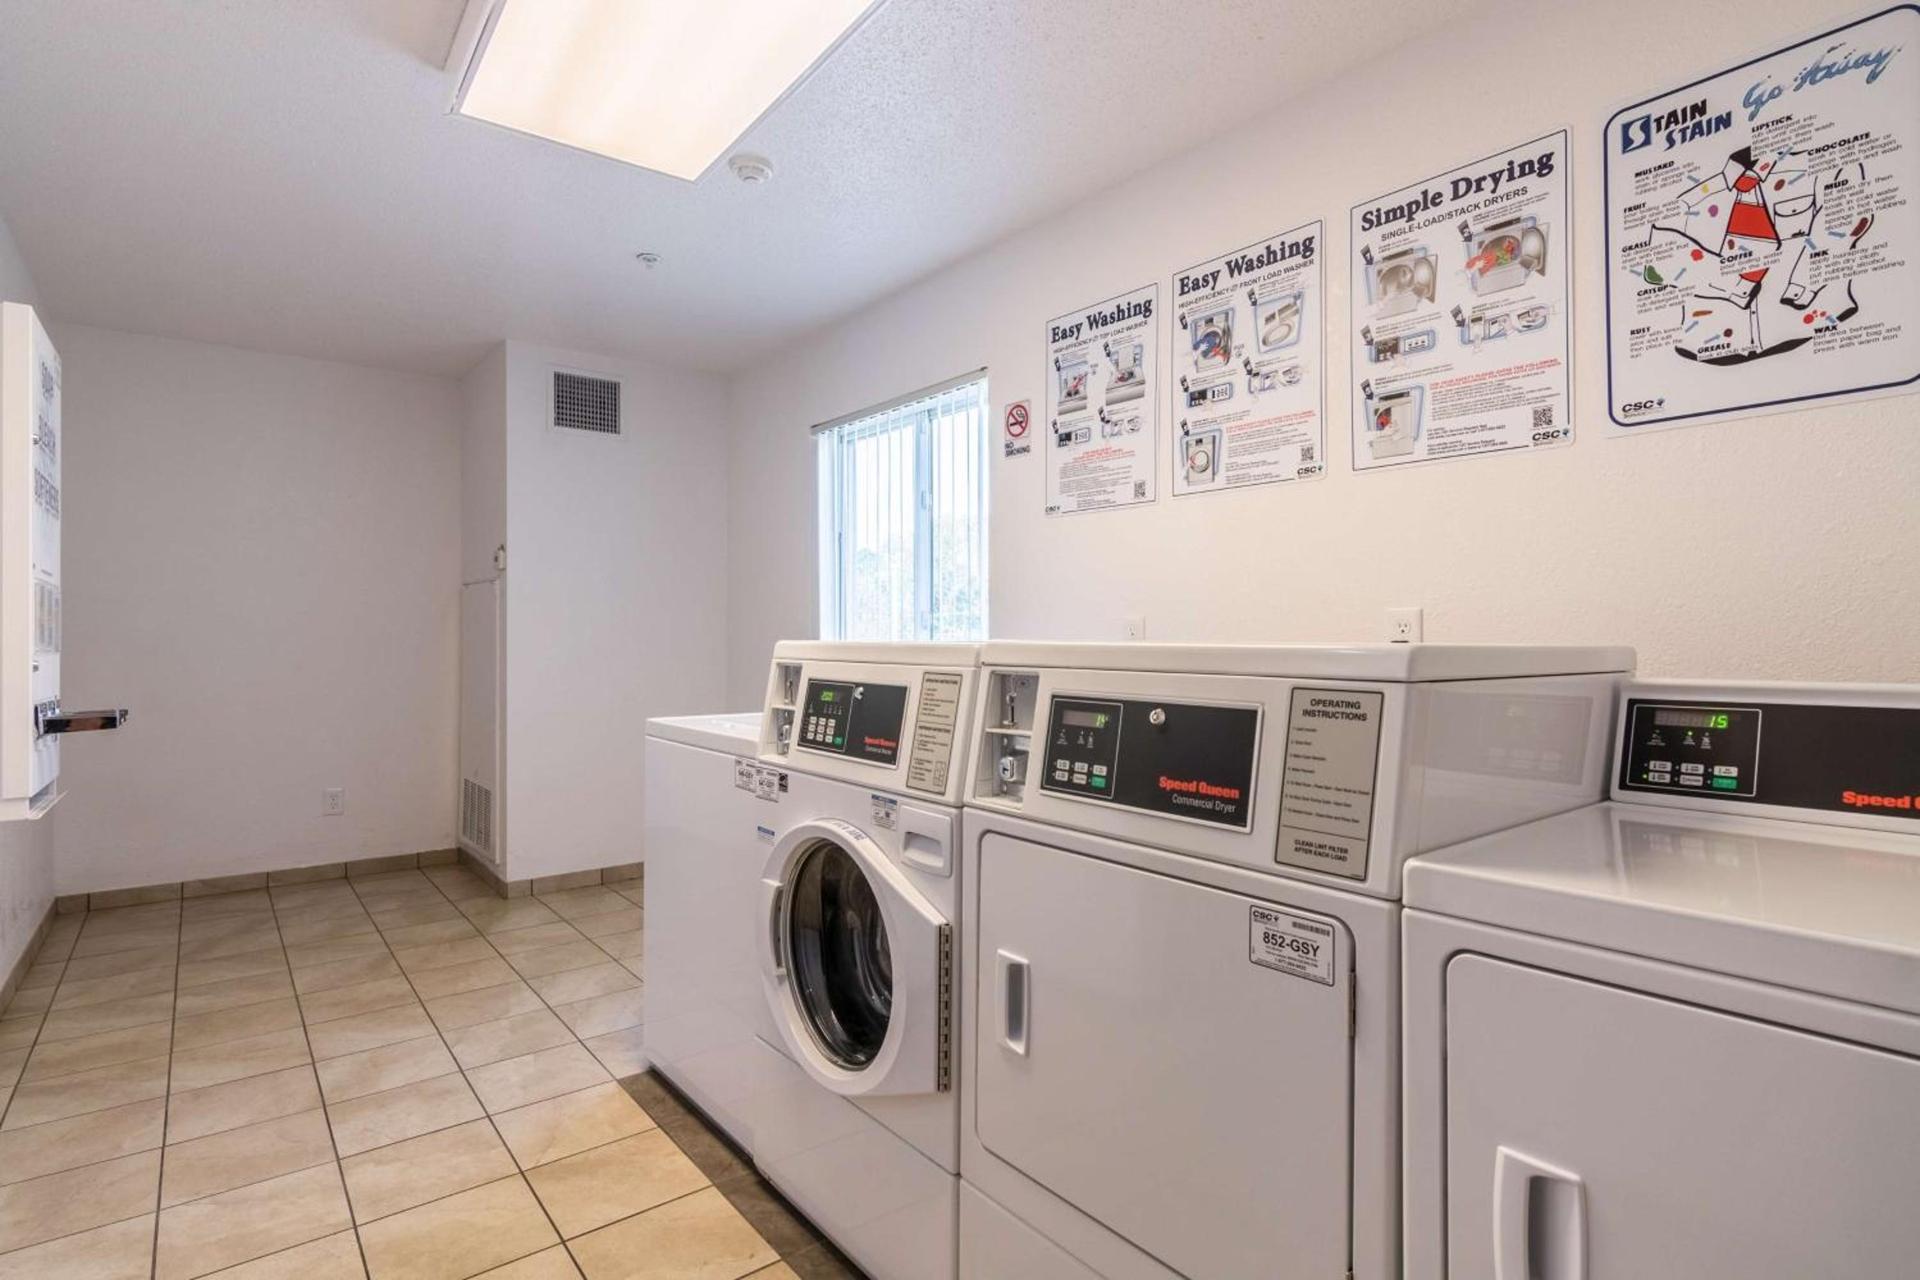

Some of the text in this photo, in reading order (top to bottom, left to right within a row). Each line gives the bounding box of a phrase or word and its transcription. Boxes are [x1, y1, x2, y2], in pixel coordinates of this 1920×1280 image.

[1743, 75, 1783, 122] Go
[1665, 110, 1732, 151] STAIN
[1752, 115, 1792, 133] LIPSTICK
[1807, 132, 1870, 156] CHOCOLATE
[1635, 161, 1674, 178] MUSTARD
[1361, 189, 1444, 231] Simple
[1450, 152, 1554, 201] Drying
[1824, 179, 1849, 191] MUD
[1381, 201, 1481, 242] SINGLE-LOAD/STACK
[1483, 186, 1528, 209] DRYERS
[1624, 202, 1646, 214] FRUIT
[1622, 241, 1649, 253] GRASS
[1720, 251, 1753, 264] COFFEE
[1810, 249, 1828, 259] INK
[1178, 269, 1221, 297] Easy
[1225, 235, 1315, 280] Washing
[1239, 276, 1261, 289] FRONT
[1263, 268, 1282, 281] LOAD
[1283, 258, 1314, 274] WASHER
[1051, 298, 1153, 344] Easy Washing
[1630, 327, 1650, 335] RUST
[1814, 325, 1837, 334] WAX
[1697, 343, 1731, 354] GREASE
[1622, 400, 1655, 413] CSC
[1532, 430, 1561, 441] CSC
[1005, 441, 1014, 449] NO
[1005, 445, 1030, 457] SMOKING
[1297, 466, 1317, 476] CSC
[1310, 698, 1361, 710] OPERATING
[1302, 709, 1368, 722] INSTRUCTIONS
[1710, 715, 1728, 728] 15
[1159, 776, 1240, 799] Speed Queen
[1171, 793, 1236, 813] Commercial Dryer
[1842, 790, 1911, 809] Speed
[1294, 839, 1314, 848] CLEAN
[1331, 853, 1348, 862] LOAD
[1252, 910, 1273, 920] CSC
[1263, 931, 1320, 957] 852-GSY
